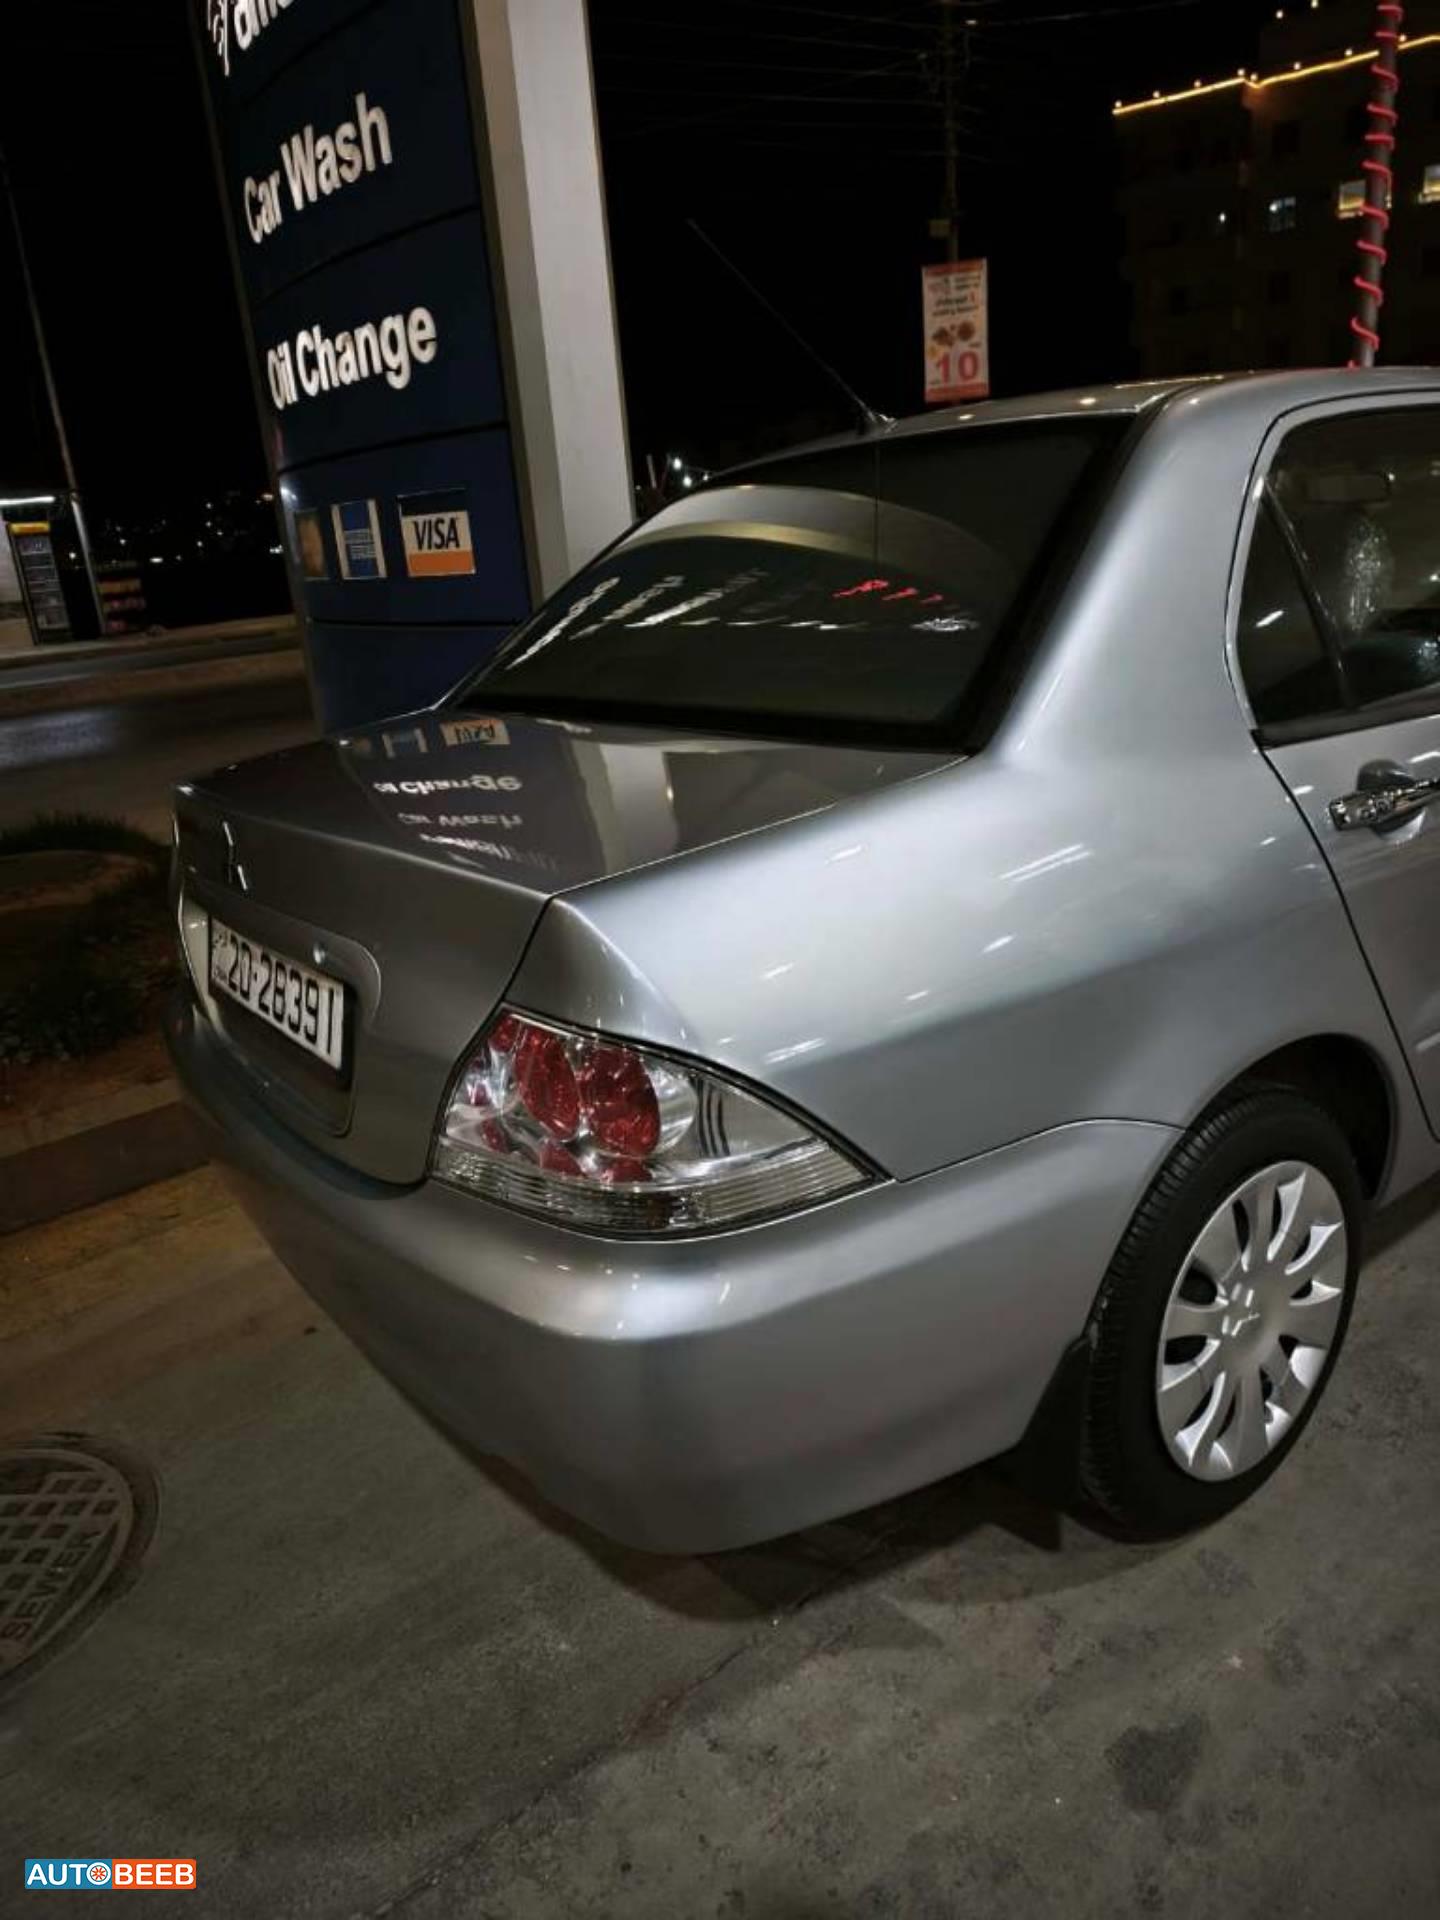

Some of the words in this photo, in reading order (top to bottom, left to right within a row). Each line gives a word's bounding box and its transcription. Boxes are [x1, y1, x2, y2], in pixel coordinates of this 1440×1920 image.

[244, 170, 283, 243] Car
[280, 92, 393, 211] Wash
[267, 340, 298, 410] Oil
[295, 306, 437, 390] Change
[935, 350, 978, 383] 10
[413, 516, 461, 550] VISA
